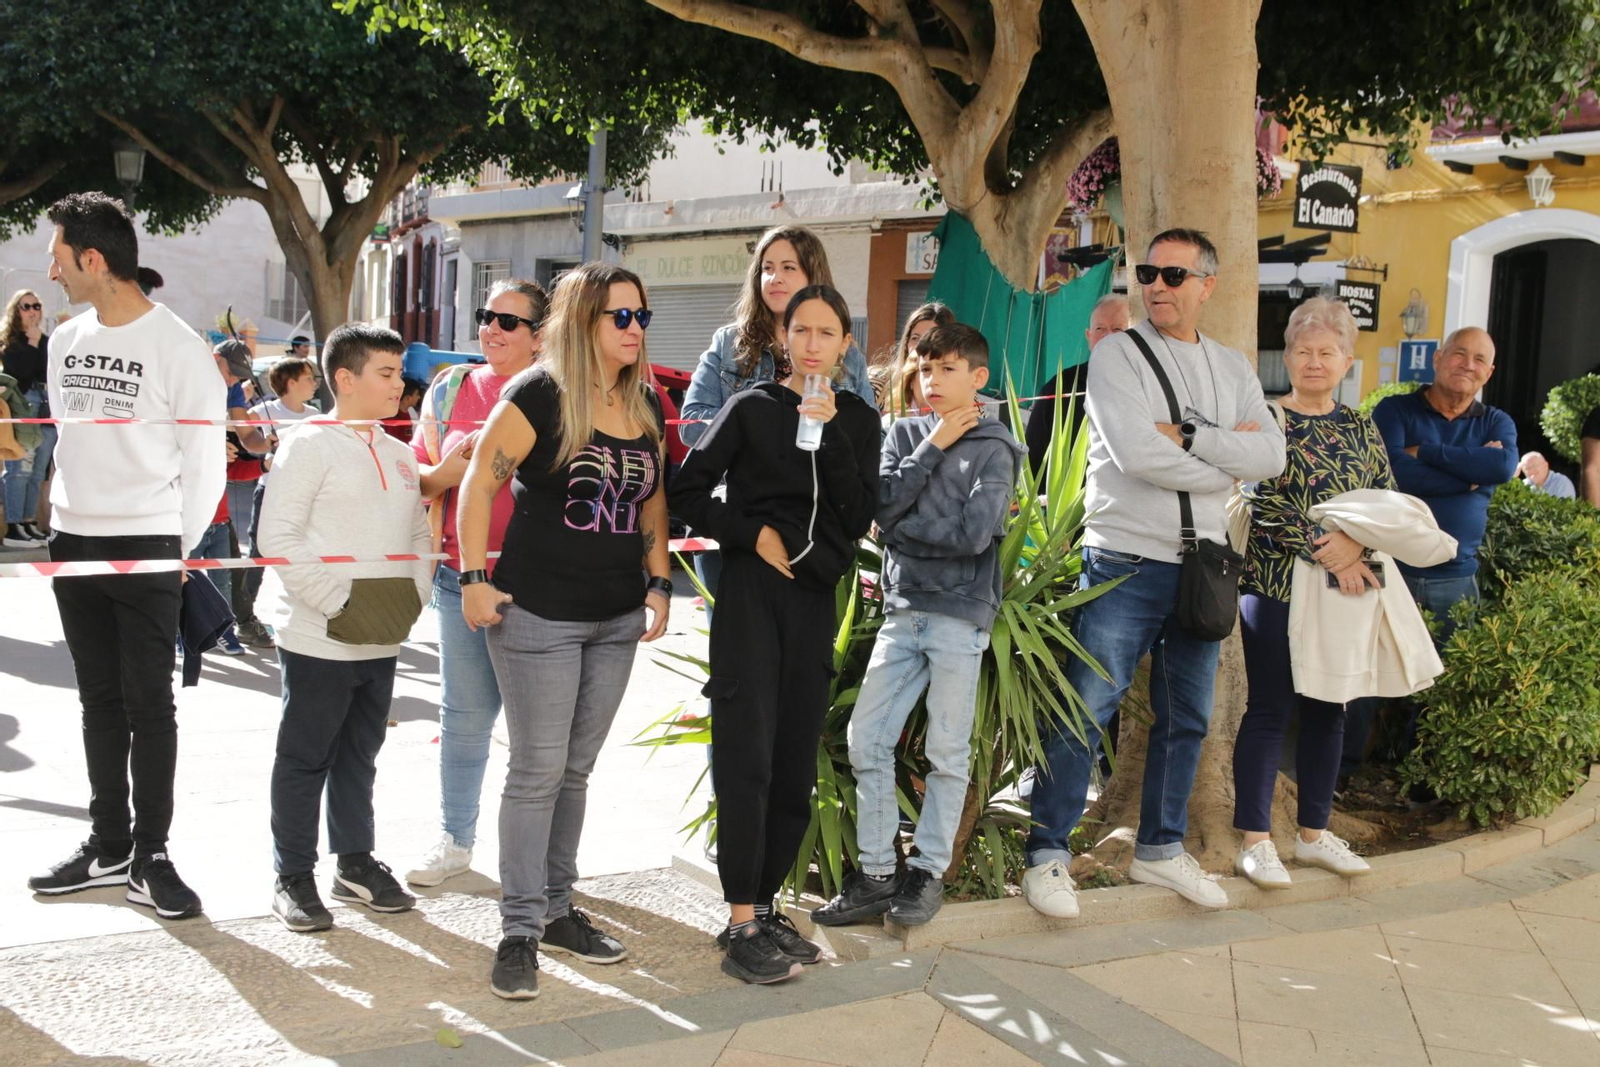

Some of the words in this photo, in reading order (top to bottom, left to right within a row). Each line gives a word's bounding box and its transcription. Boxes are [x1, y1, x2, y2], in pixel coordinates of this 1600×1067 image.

[1301, 167, 1357, 198] Restaurante
[1298, 198, 1311, 223] El
[1312, 199, 1355, 228] Canario
[657, 256, 695, 278] DULCE
[1340, 285, 1375, 300] HOSTAL
[64, 354, 143, 377] G-STAR
[63, 375, 138, 396] ORIGINALS
[105, 397, 134, 409] DENIM
